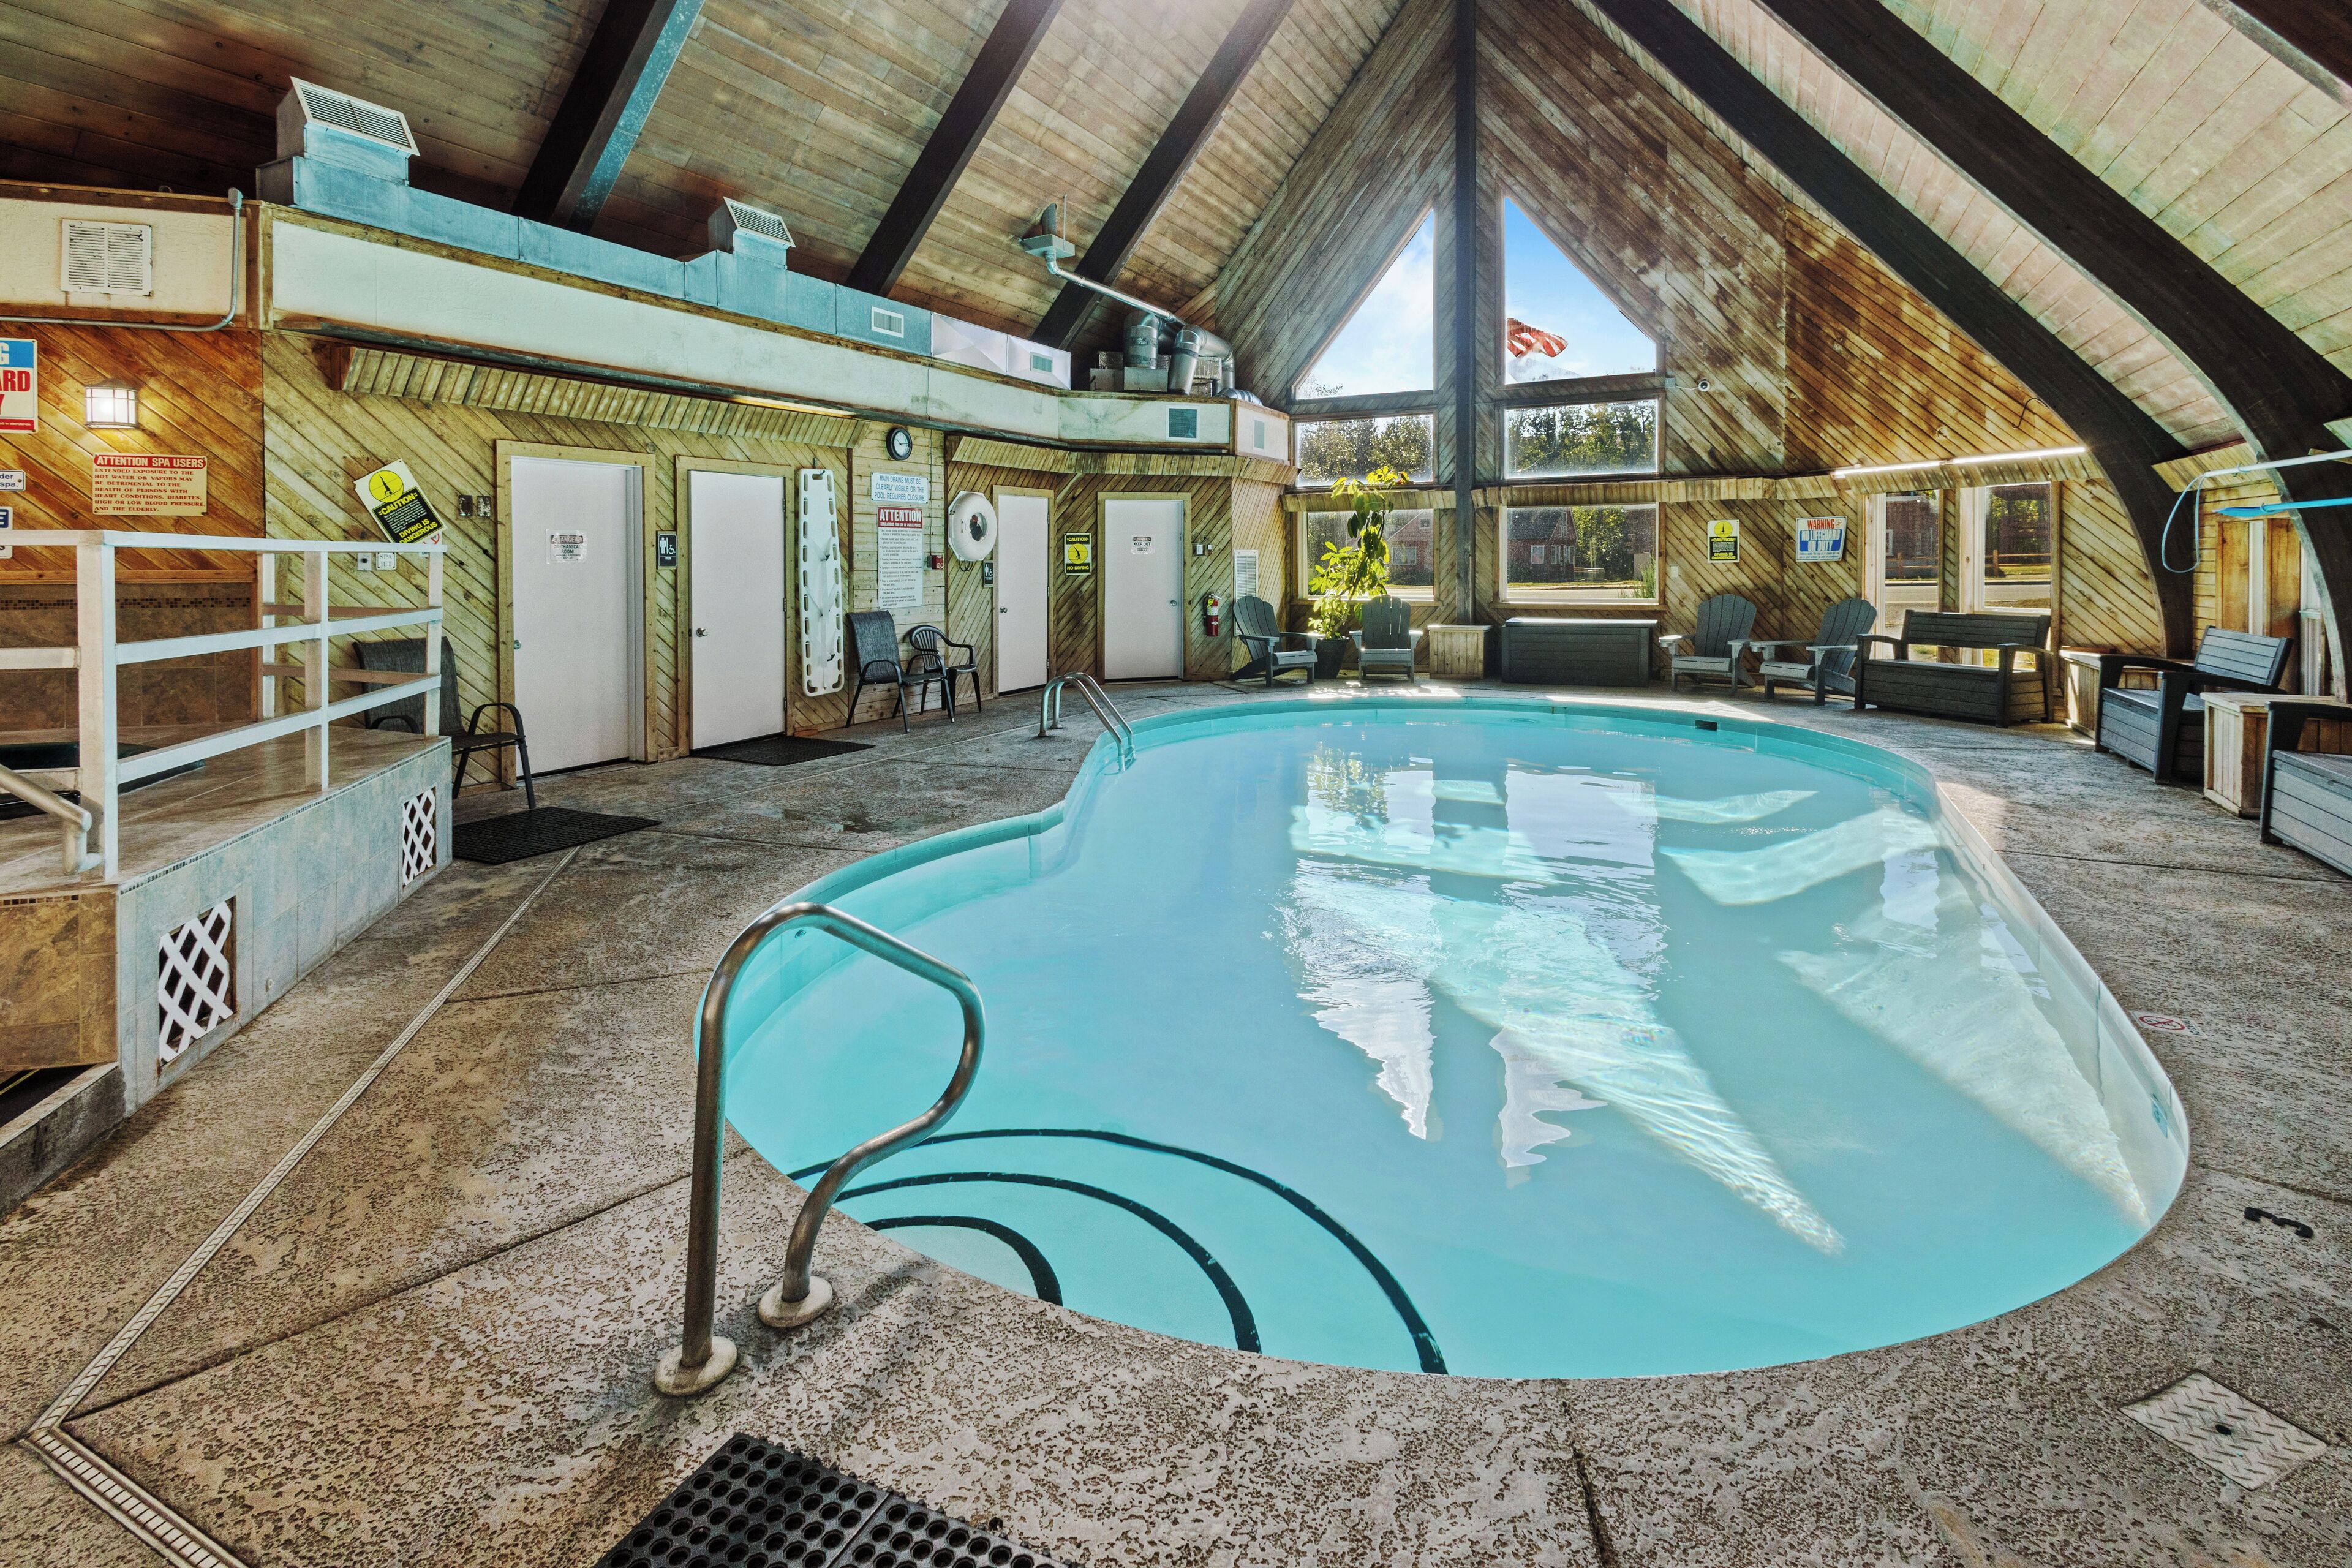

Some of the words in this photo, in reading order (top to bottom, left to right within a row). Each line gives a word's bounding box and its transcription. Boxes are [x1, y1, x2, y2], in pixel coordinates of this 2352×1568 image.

[0, 370, 30, 392] RD
[97, 456, 148, 466] ATTENTION
[152, 458, 170, 467] SPA
[173, 459, 203, 468] USERS
[880, 509, 921, 522] ATTENTION
[399, 523, 423, 538] DIVING
[1807, 519, 1834, 530] WARNING
[399, 522, 437, 543] DANGEROUS
[1802, 530, 1809, 541] NO
[1811, 529, 1840, 541] LIFEGUARD
[1808, 540, 1816, 551] ON
[1818, 540, 1833, 551] DUTY
